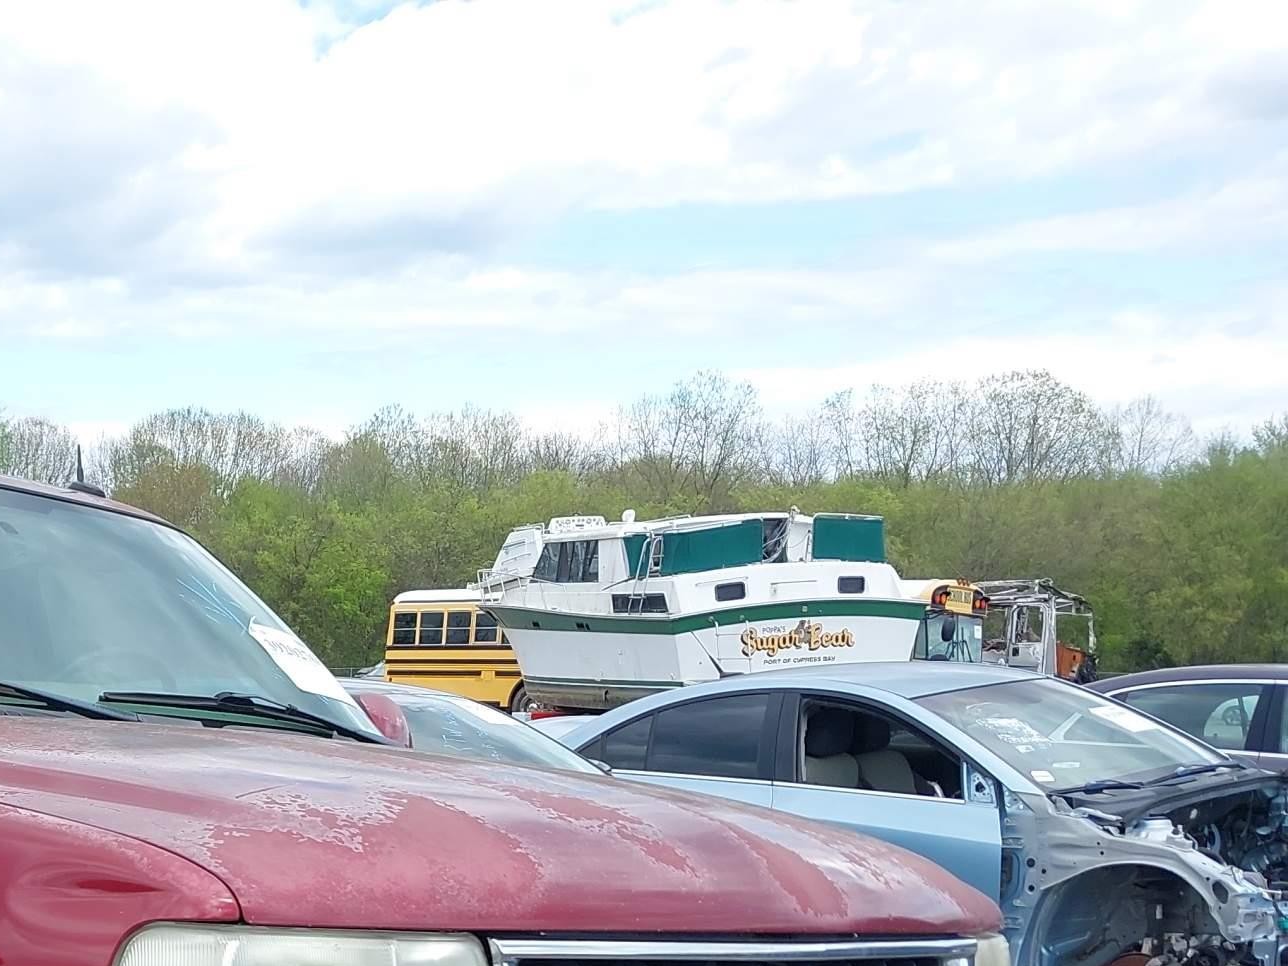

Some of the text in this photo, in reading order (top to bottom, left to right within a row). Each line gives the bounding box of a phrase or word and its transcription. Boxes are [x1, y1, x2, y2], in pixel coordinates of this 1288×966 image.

[762, 625, 786, 634] POPPA'S
[740, 622, 855, 658] Sugar Bear
[792, 656, 821, 664] CYPRESS
